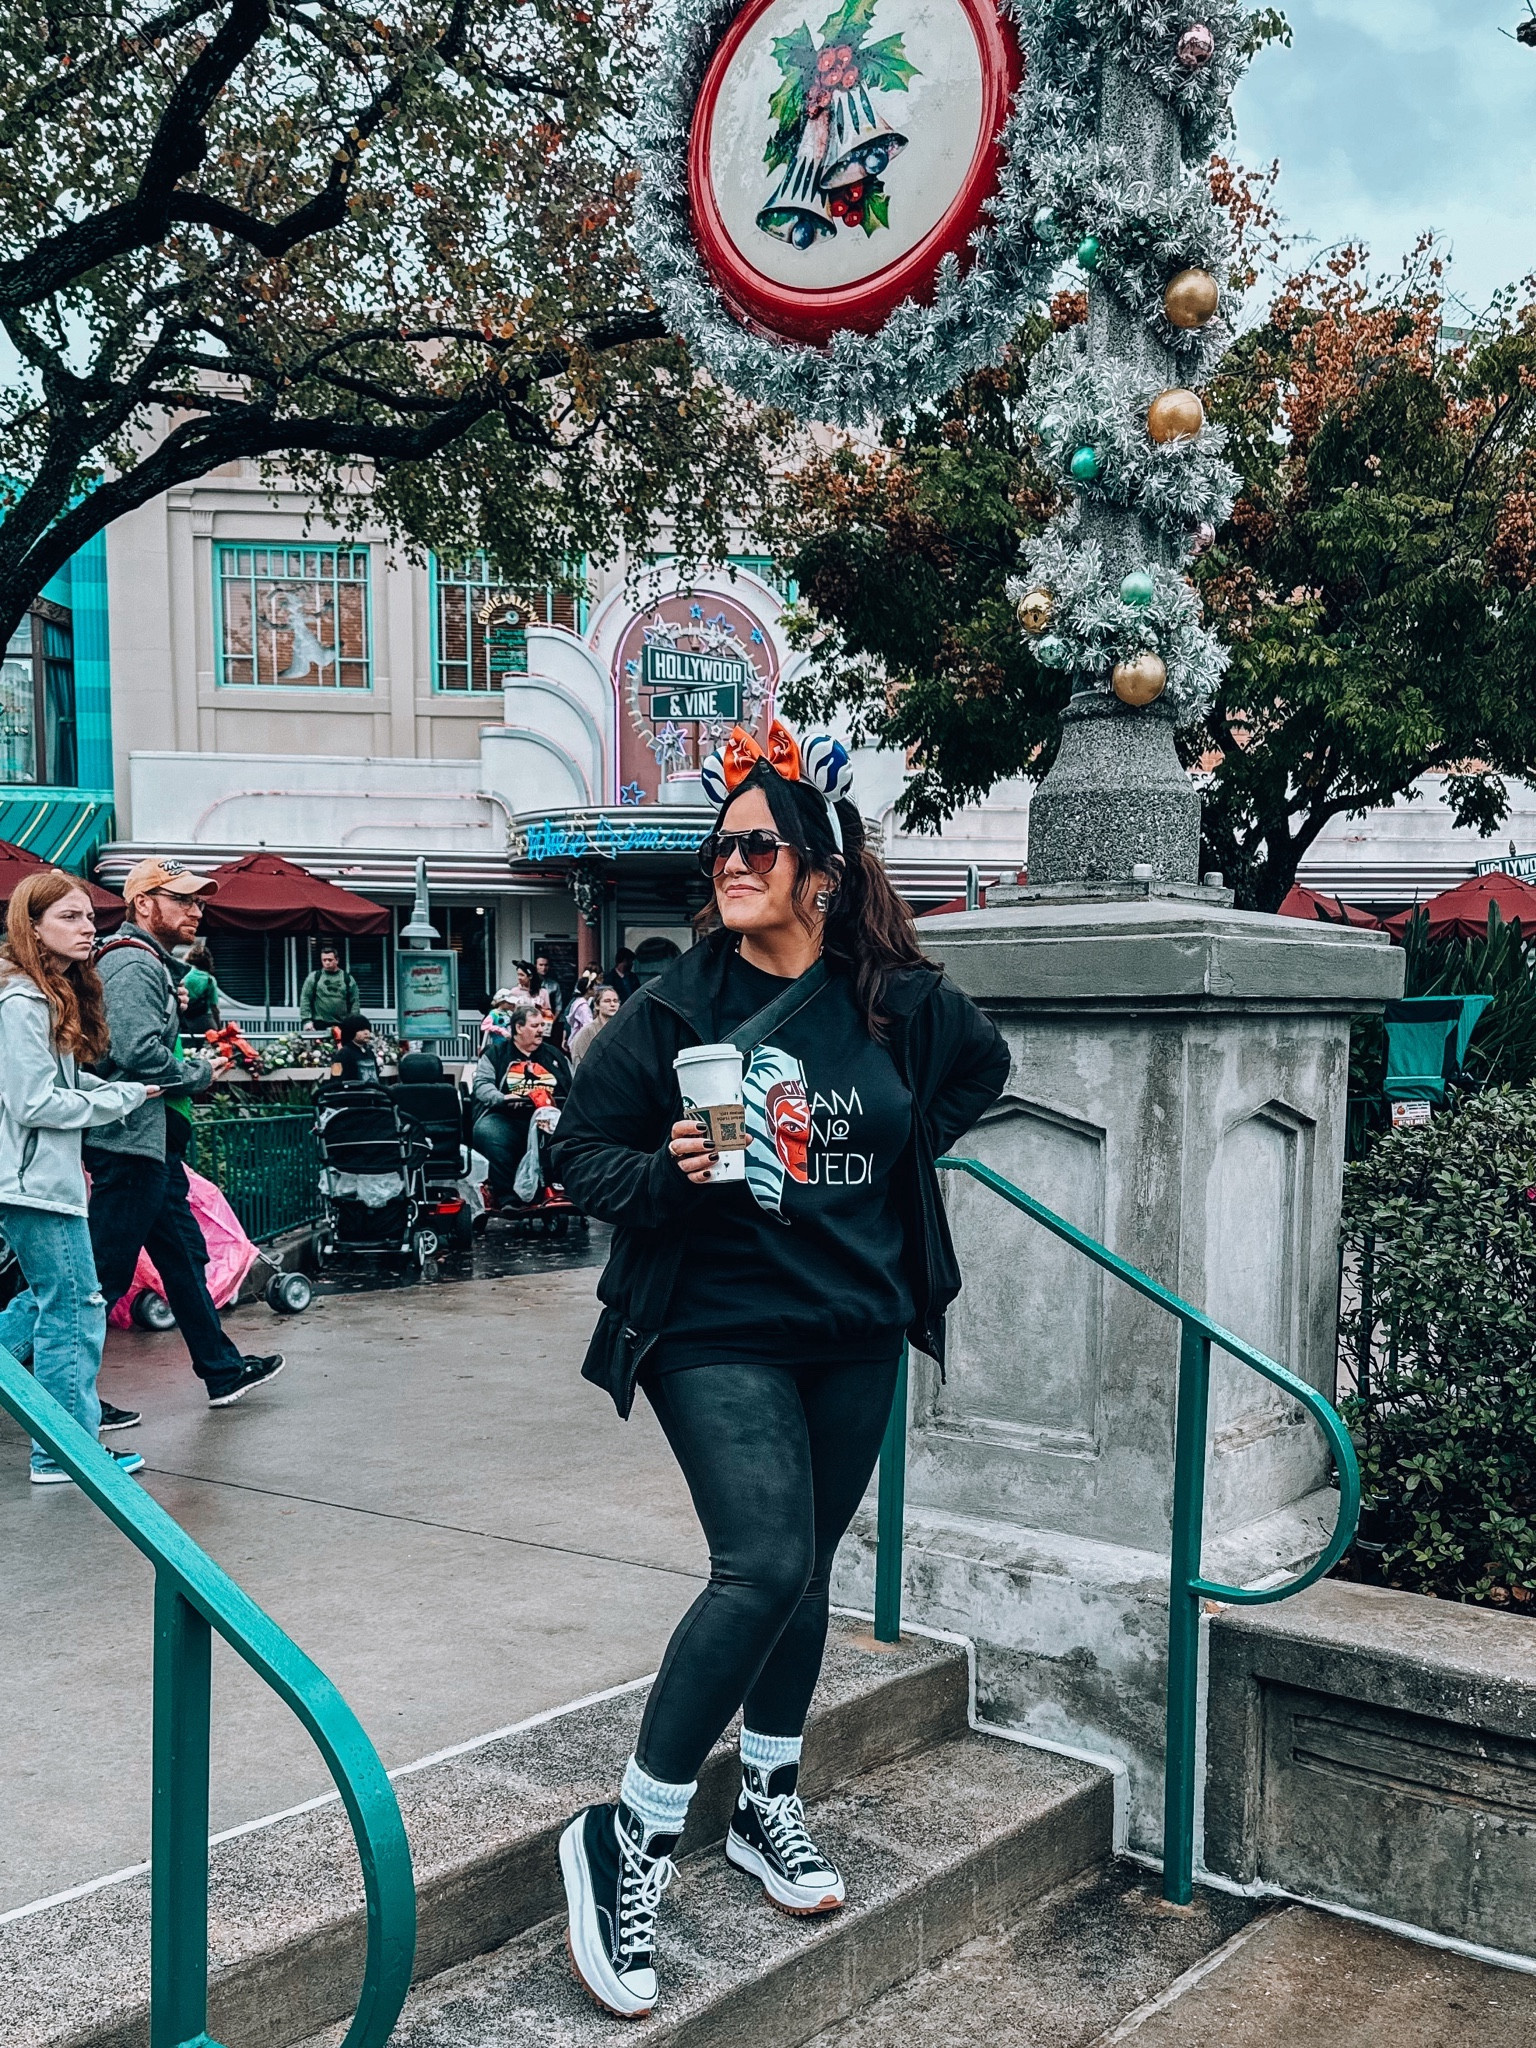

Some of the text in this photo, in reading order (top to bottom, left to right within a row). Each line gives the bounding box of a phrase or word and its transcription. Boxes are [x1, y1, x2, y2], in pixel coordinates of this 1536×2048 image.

[477, 593, 539, 625] EDDIE VALIAN
[655, 652, 742, 682] HOLLYWOOD
[669, 690, 718, 716] & VINE
[799, 1059, 809, 1089] I
[809, 1086, 863, 1115] AM
[808, 1153, 874, 1185] JEDI
